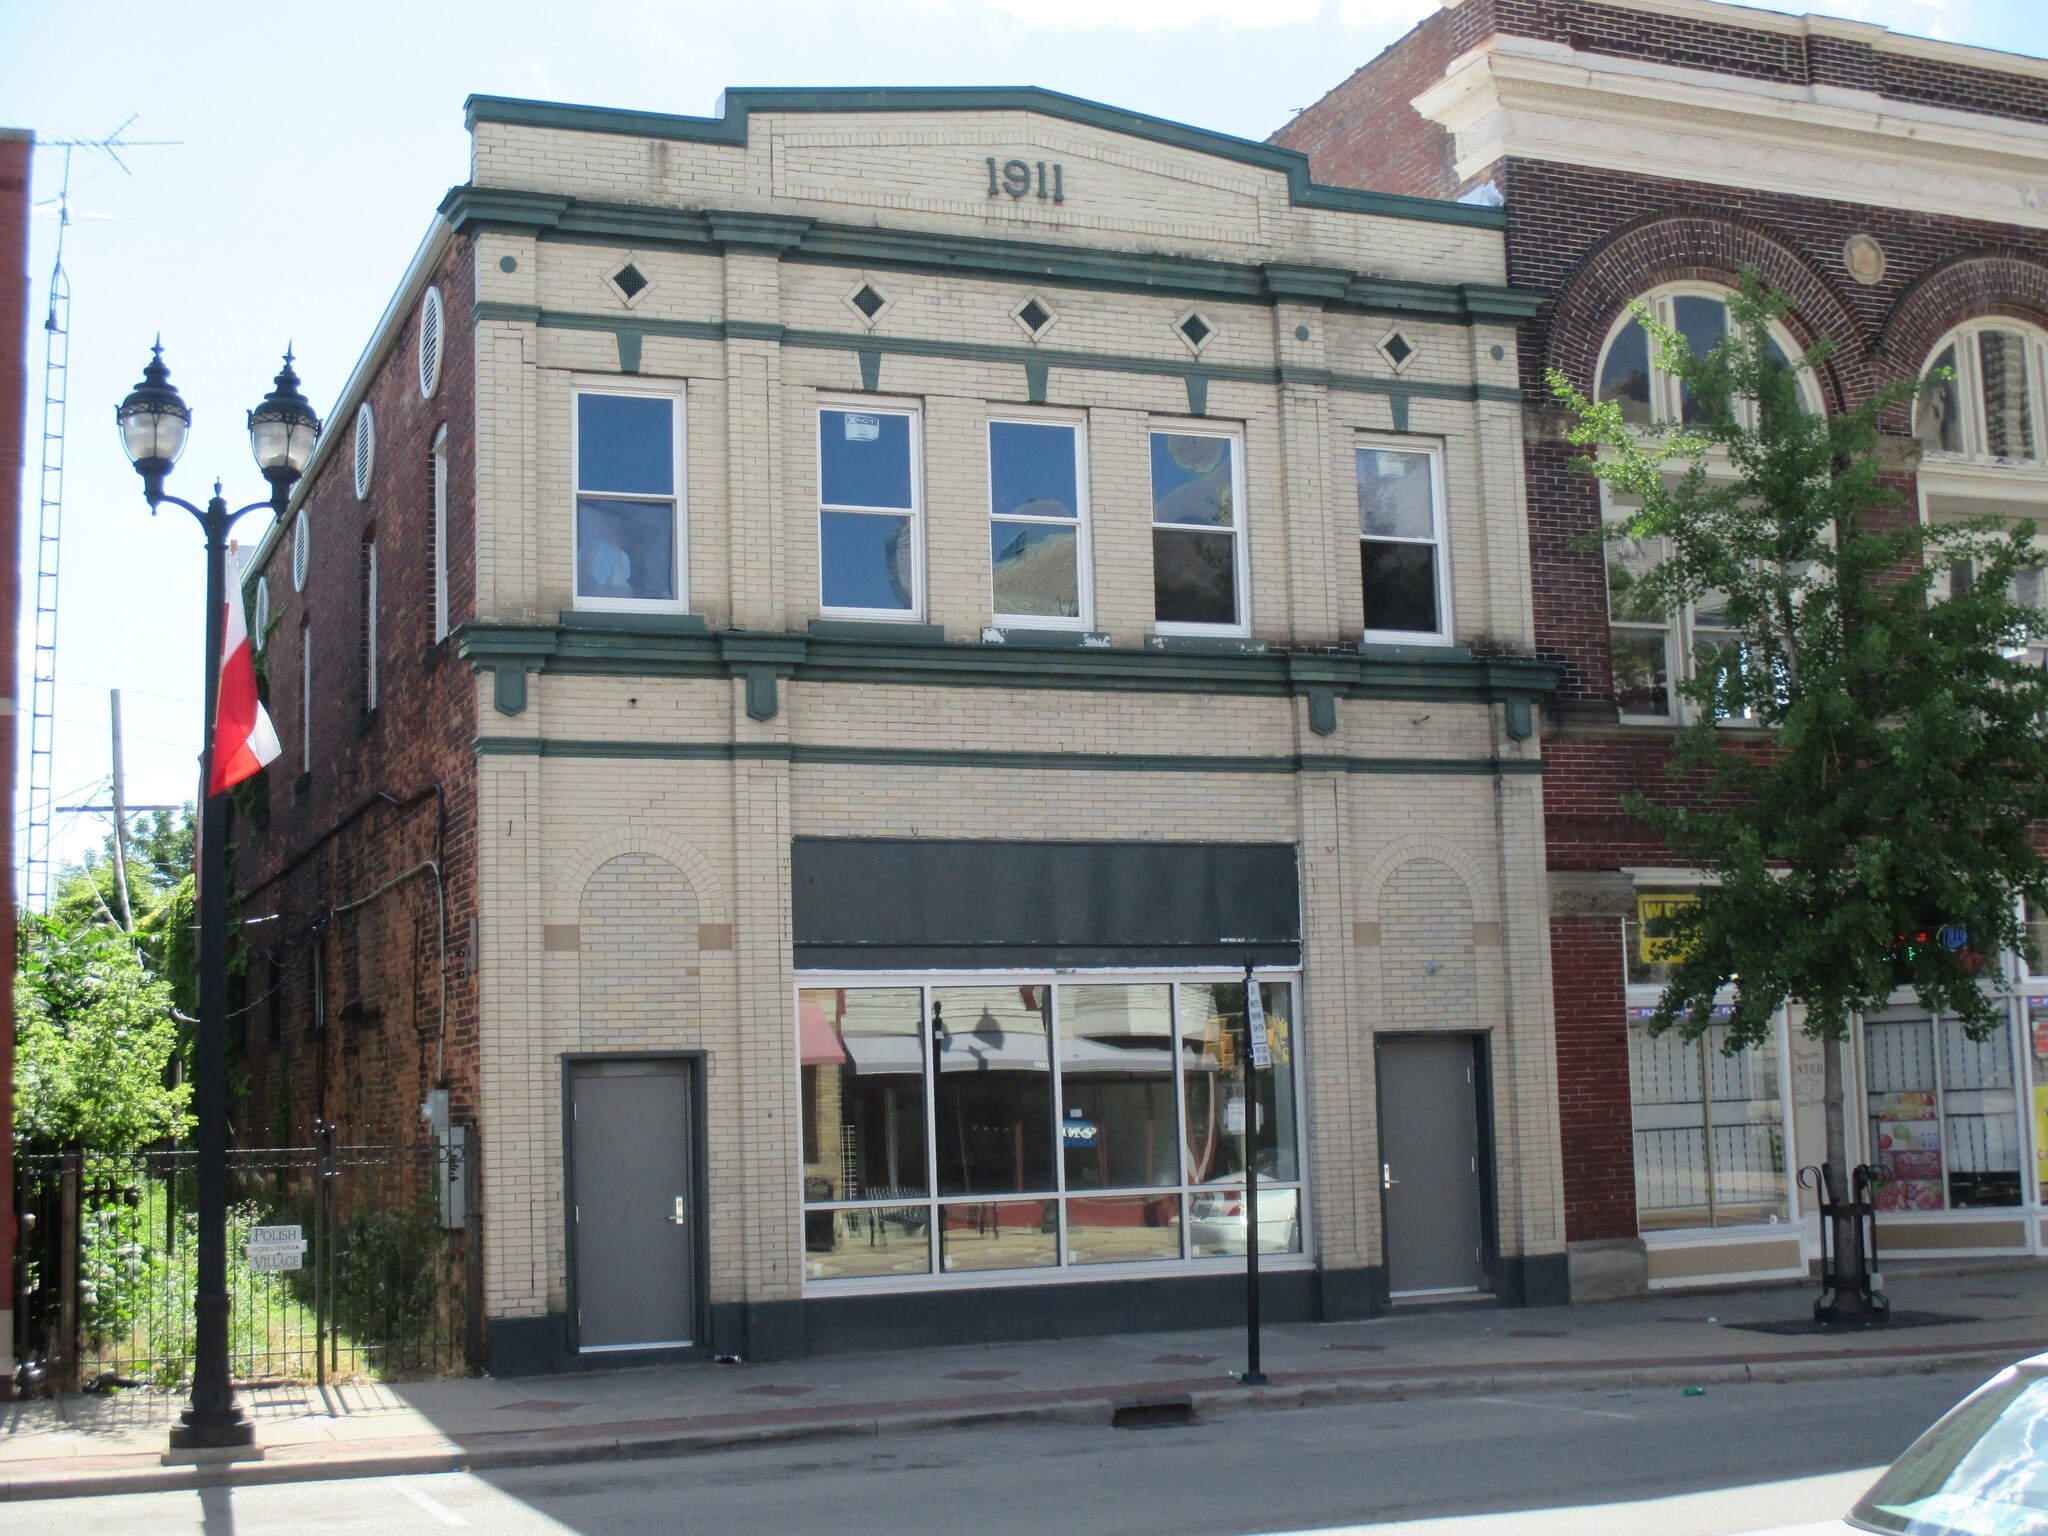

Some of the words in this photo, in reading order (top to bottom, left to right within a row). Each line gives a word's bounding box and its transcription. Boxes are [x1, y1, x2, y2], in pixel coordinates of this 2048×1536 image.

[986, 157, 1065, 202] 1911
[1793, 1063, 1824, 1075] NTER
[253, 1228, 296, 1242] POLISH
[254, 1256, 299, 1269] VILLAGE
